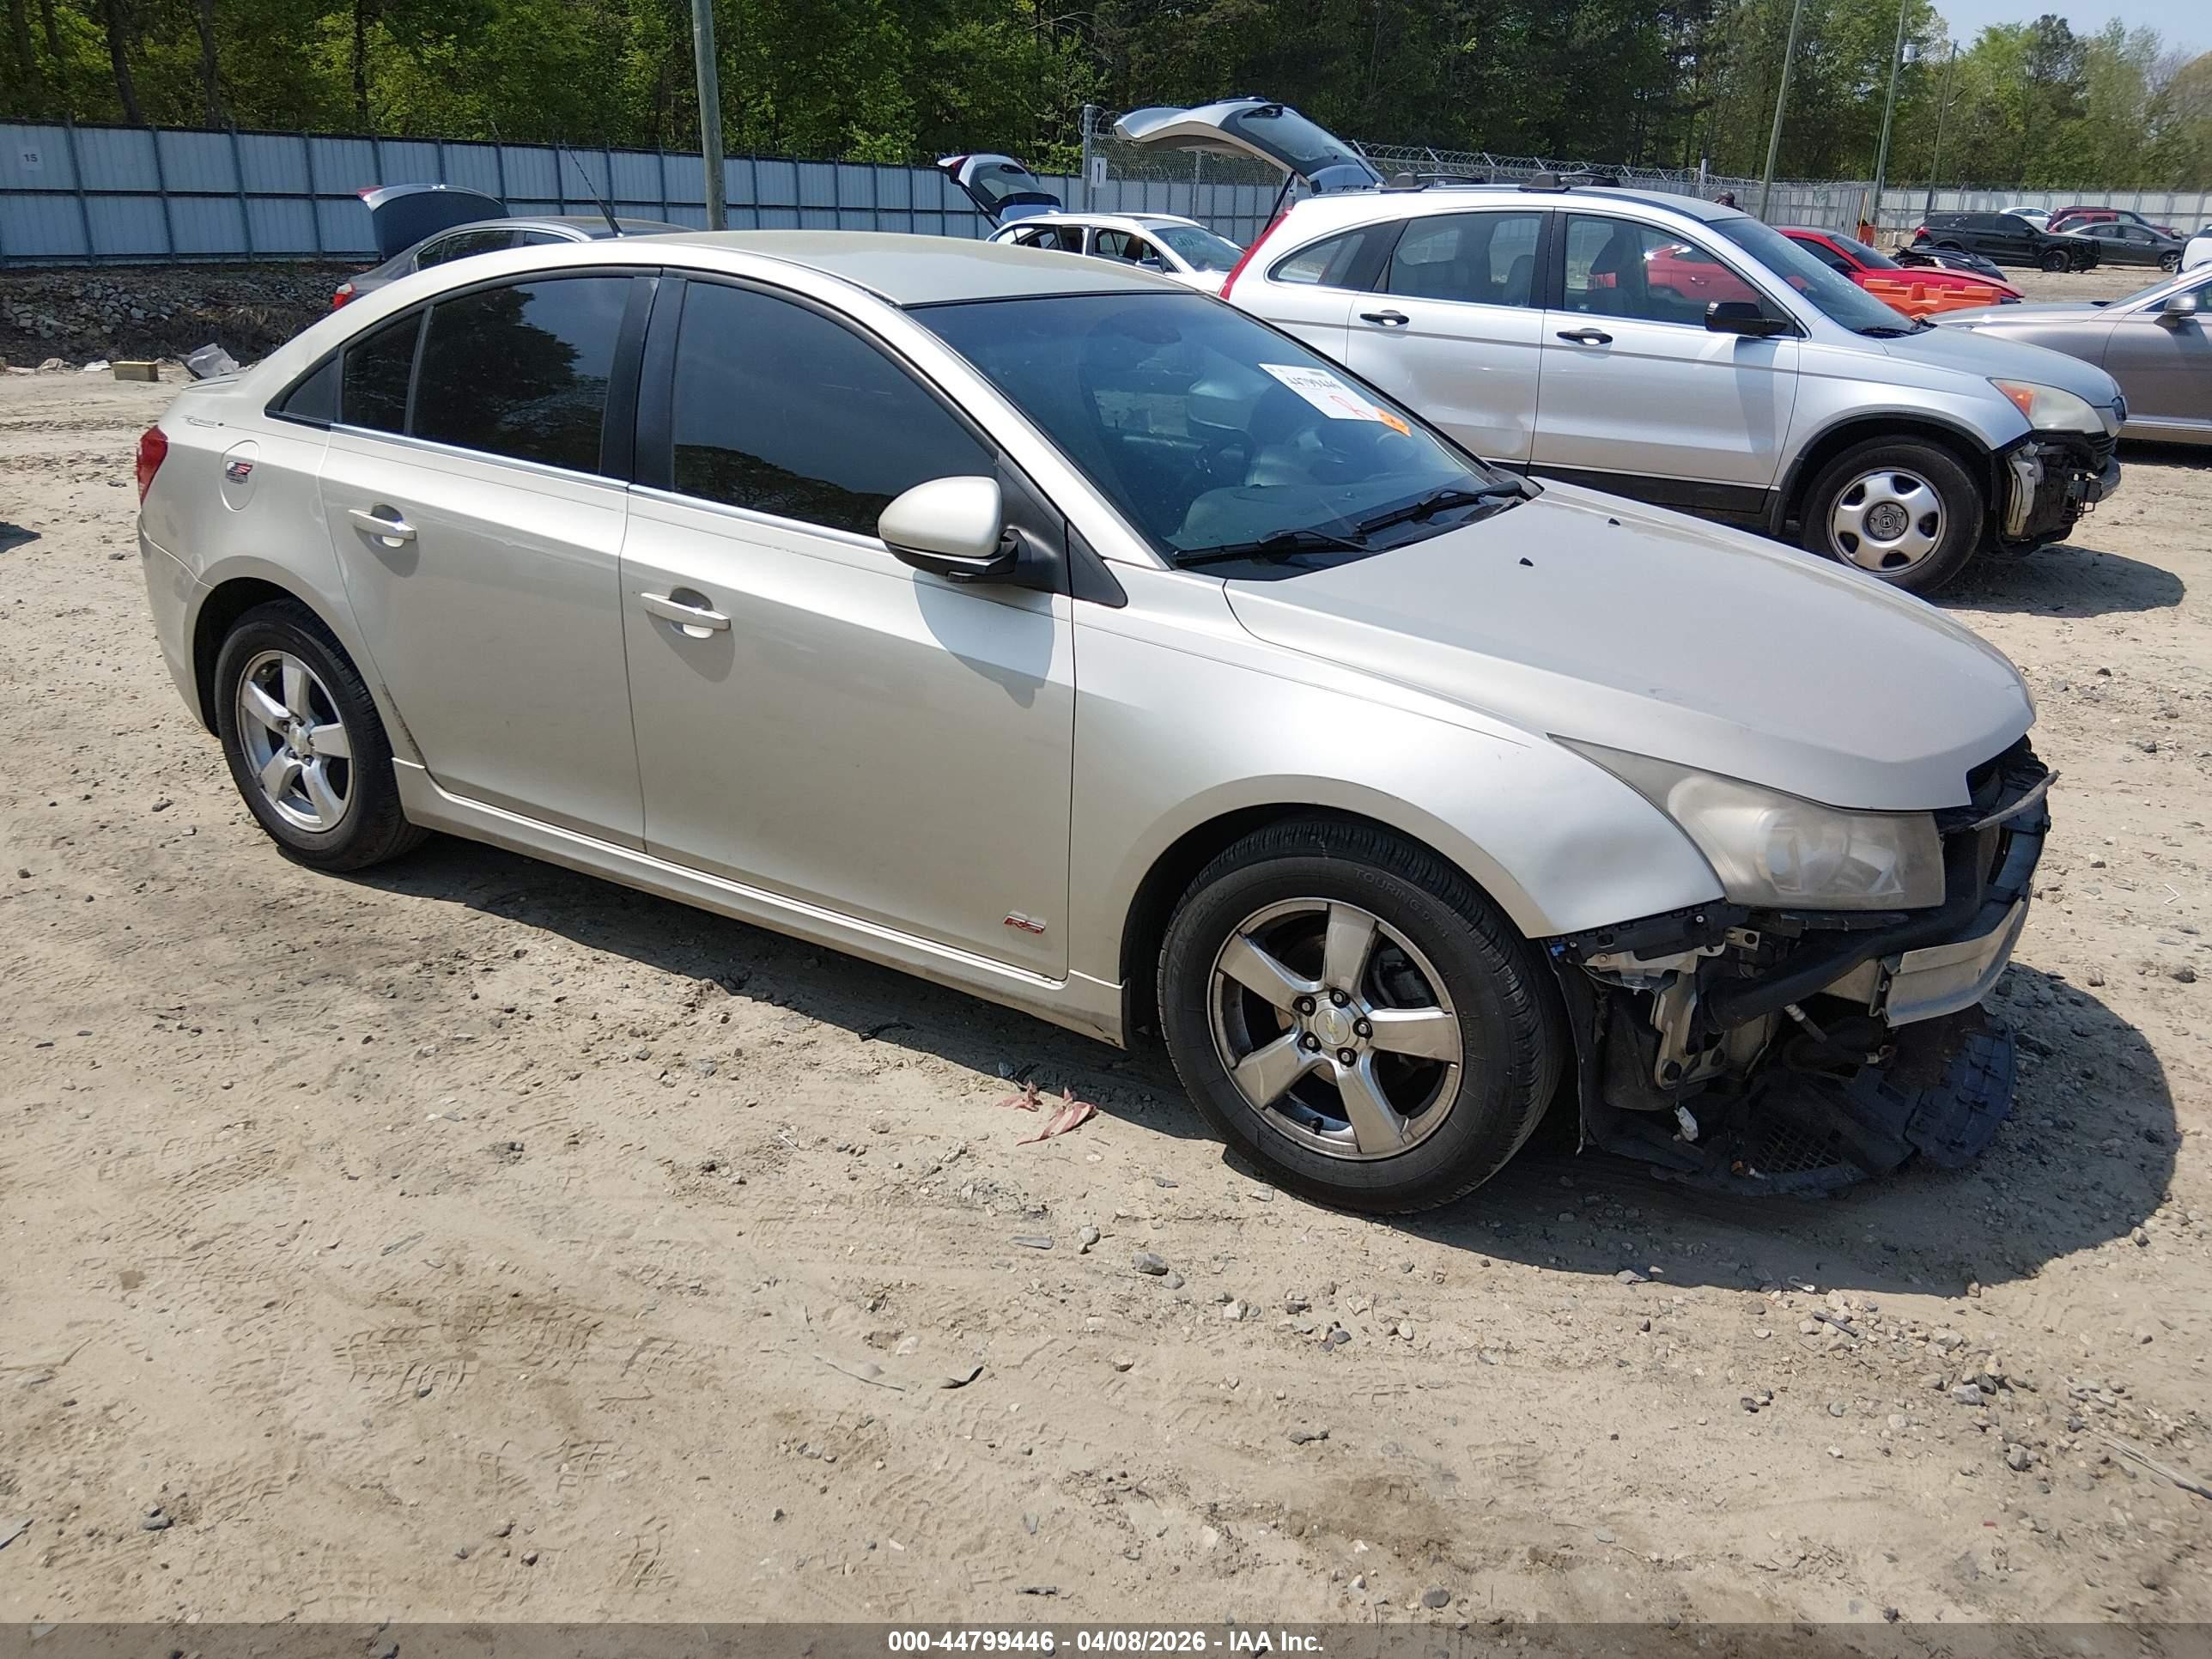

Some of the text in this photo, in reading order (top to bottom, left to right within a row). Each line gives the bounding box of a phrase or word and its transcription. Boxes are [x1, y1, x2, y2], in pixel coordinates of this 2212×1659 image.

[23, 153, 39, 163] 15
[1097, 162, 1101, 184] 1
[1352, 866, 1424, 912] TOURING
